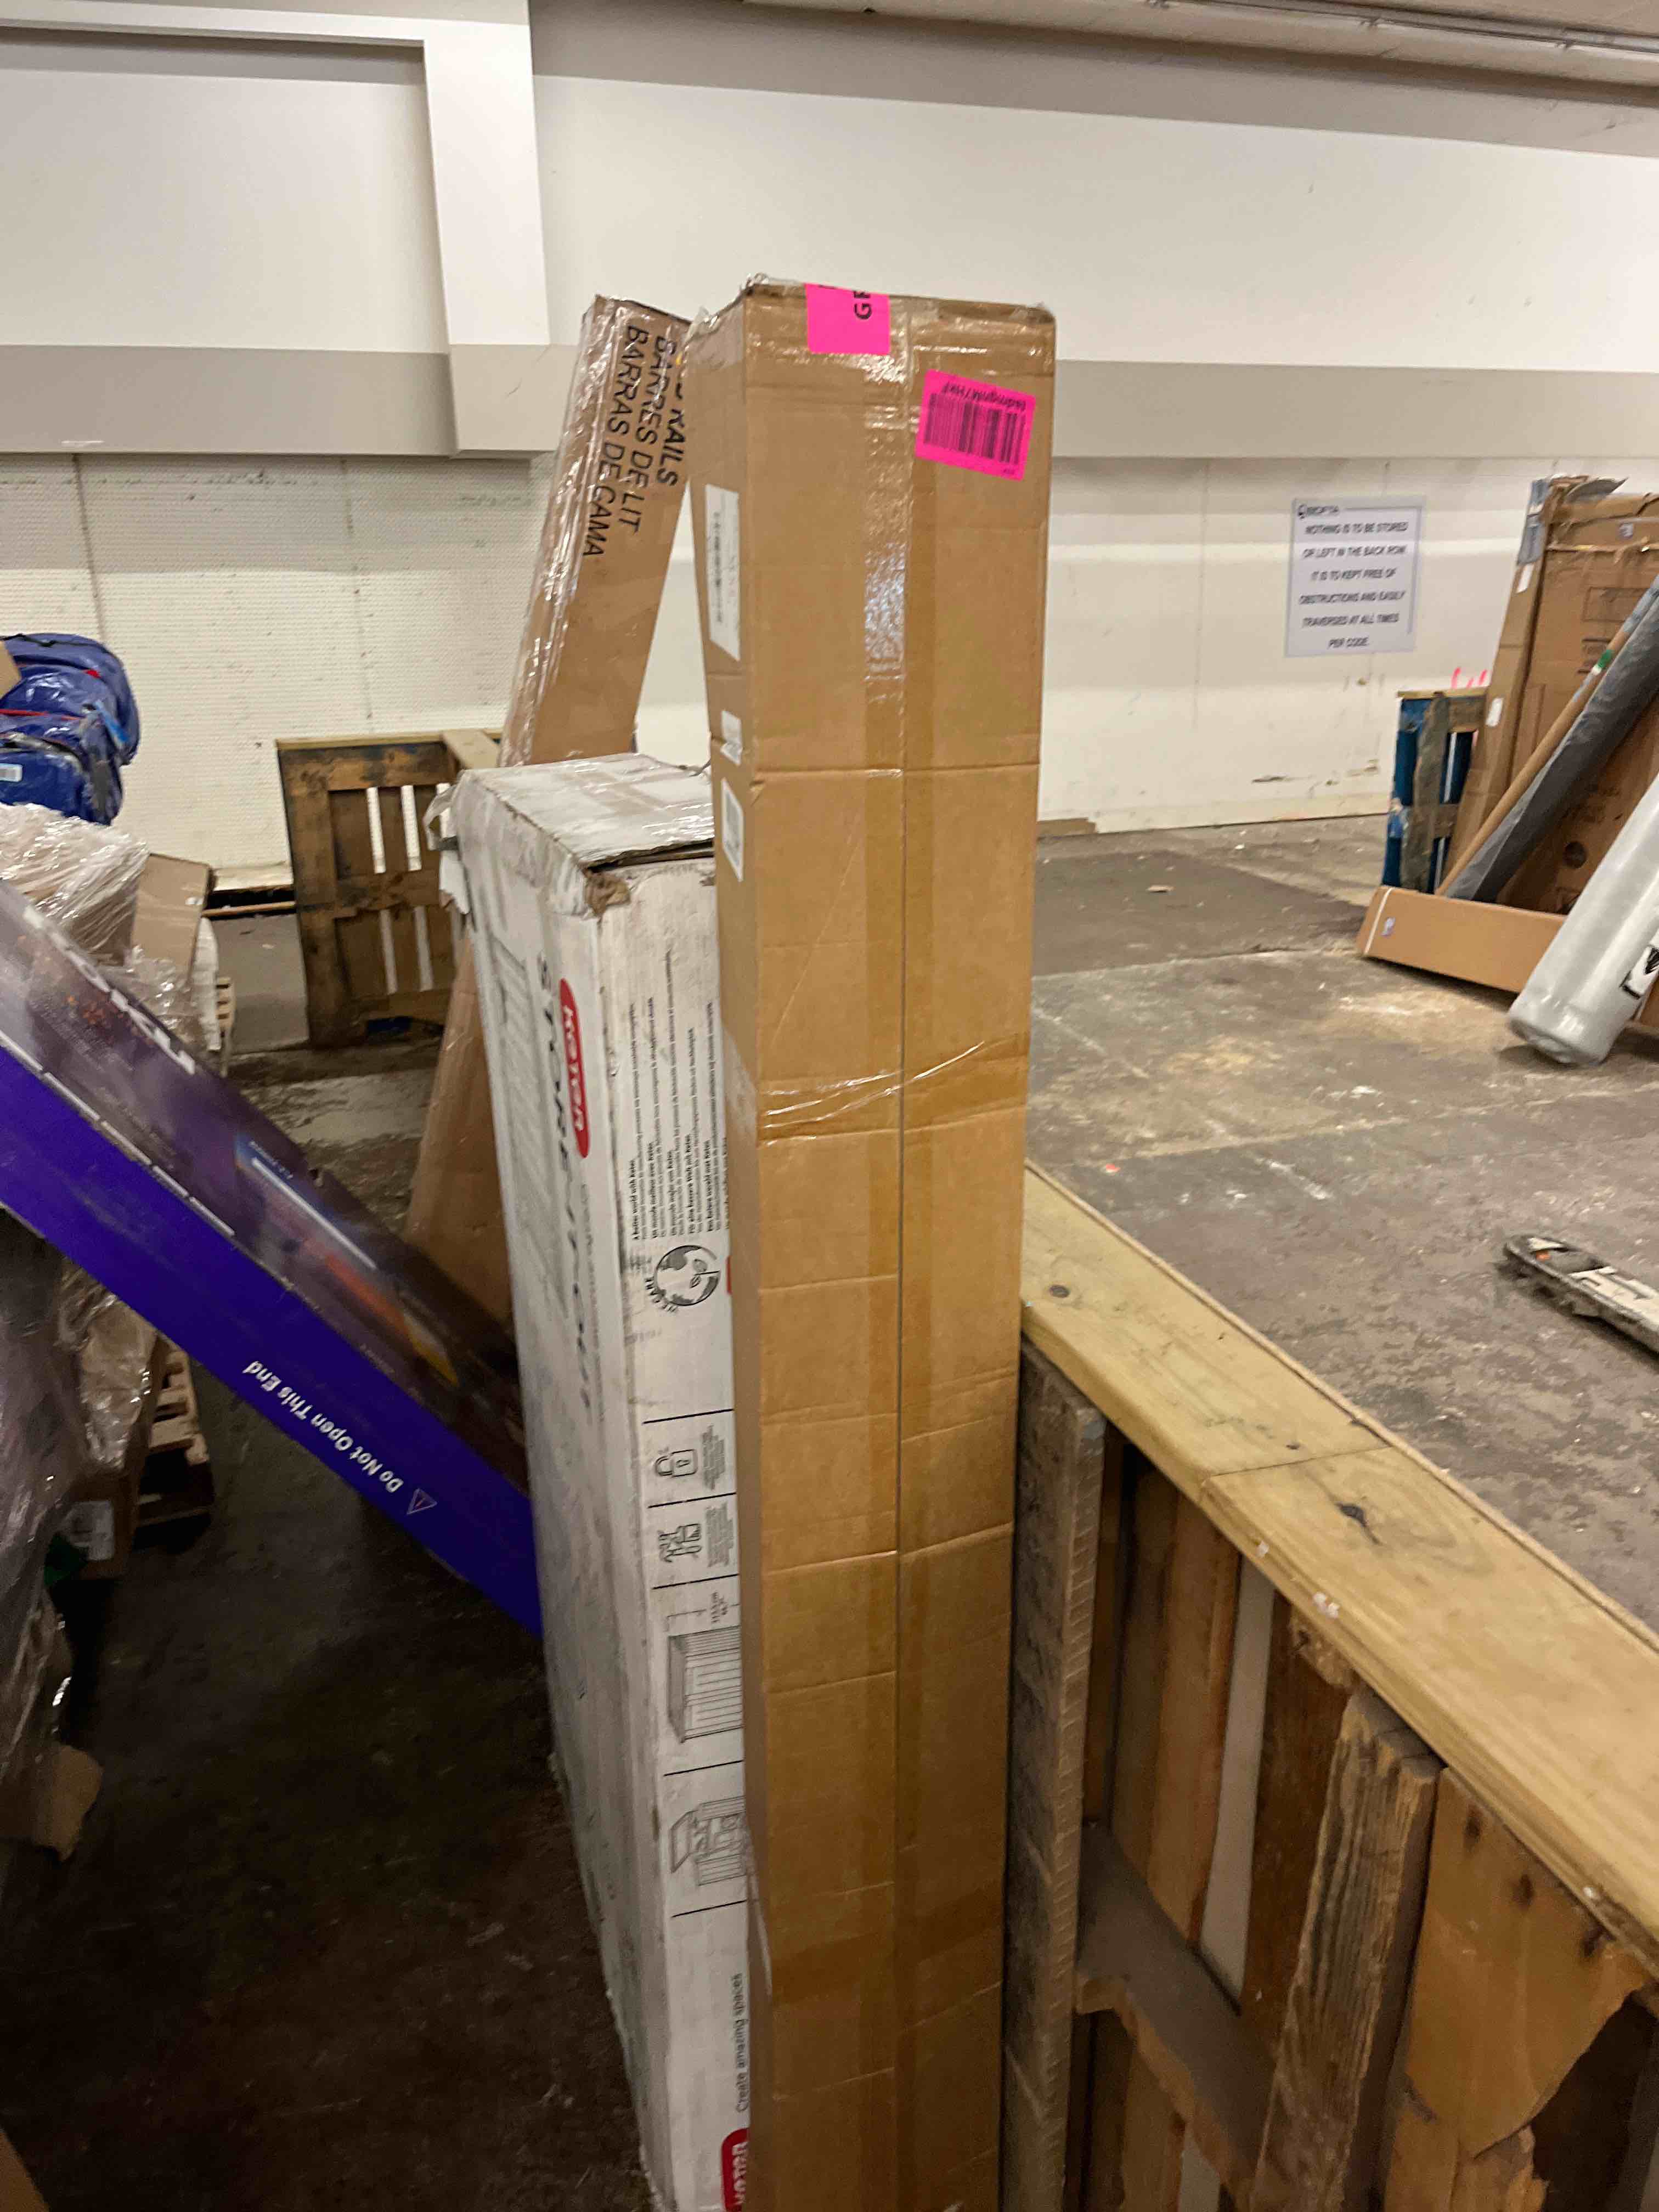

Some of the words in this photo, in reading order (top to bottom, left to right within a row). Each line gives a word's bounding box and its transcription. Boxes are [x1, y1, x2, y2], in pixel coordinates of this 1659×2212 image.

[608, 324, 648, 436] BARRAS
[636, 336, 678, 444] BARRES
[598, 443, 625, 479] DE
[627, 450, 653, 488] DE
[583, 485, 617, 557] CAMA
[619, 492, 645, 534] LIT
[1306, 524, 1340, 534] NOTHING
[1344, 524, 1349, 533] IS
[1352, 523, 1362, 533] TO
[1364, 523, 1374, 533] BE
[1376, 522, 1408, 532] STORED
[1303, 549, 1314, 558] OR
[1316, 548, 1336, 557] LEFT
[1337, 548, 1345, 556] IN
[1347, 547, 1363, 556] THE
[1364, 546, 1385, 556] BACK
[1320, 571, 1328, 580] IS
[1330, 571, 1339, 580] TO
[1341, 570, 1362, 579] KEPT
[1363, 569, 1383, 578] FREE
[1385, 568, 1396, 578] OF
[1299, 593, 1359, 604] OBSTRUCTIONS
[1361, 592, 1376, 601] AND
[1378, 591, 1406, 600] EASILY
[1302, 616, 1348, 627] TRAVERSED
[1348, 614, 1361, 624] AT
[1361, 614, 1374, 623] ALL
[1377, 613, 1399, 623] TIMES
[1329, 638, 1344, 648] PER
[242, 1361, 281, 1391] End
[277, 1386, 313, 1420] This
[311, 1413, 354, 1451] Open
[350, 1446, 383, 1476] Not
[379, 1470, 404, 1493] Do
